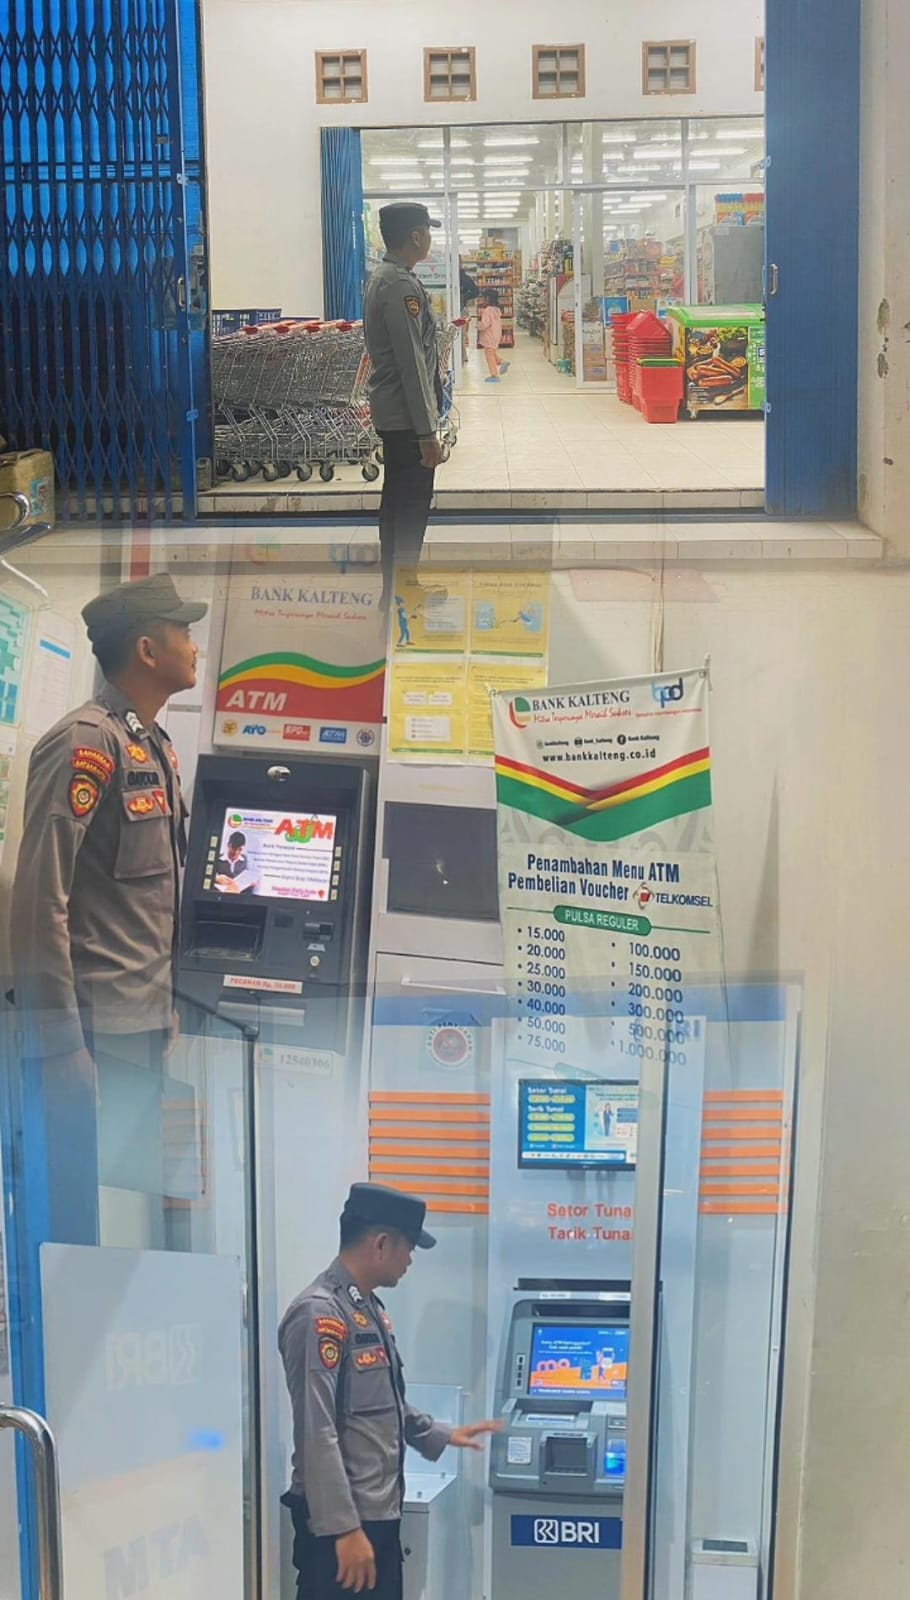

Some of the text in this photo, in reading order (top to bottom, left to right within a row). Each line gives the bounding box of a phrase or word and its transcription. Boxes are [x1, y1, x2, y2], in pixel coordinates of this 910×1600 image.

[251, 586, 374, 606] BANK KALTENG
[226, 689, 288, 711] ATM
[532, 690, 631, 712] BANK KALTENG
[542, 748, 656, 762] www.bankkalteng.co.id
[274, 818, 334, 840] ATM
[528, 854, 680, 883] Penambahan Menu ATM
[508, 872, 629, 901] Pembelian Voucher
[656, 892, 714, 907] TELKOMSEL
[565, 910, 640, 931] PULSA REGULER
[527, 926, 566, 942] 15.000
[527, 943, 566, 960] 20.000
[629, 942, 681, 961] 100.000
[527, 962, 566, 979] 25.000
[629, 962, 682, 982] 150.000
[527, 980, 566, 998] 30.000
[628, 982, 684, 1003] 200.000
[527, 998, 566, 1016] 40.000
[628, 1002, 685, 1024] 300.000
[527, 1016, 566, 1035] 50.000
[629, 1021, 686, 1045] 500.000
[527, 1034, 566, 1053] 75.000
[547, 1203, 634, 1217] Setor Tuna
[547, 1225, 587, 1240] Tarik
[561, 1520, 600, 1543] BRI
